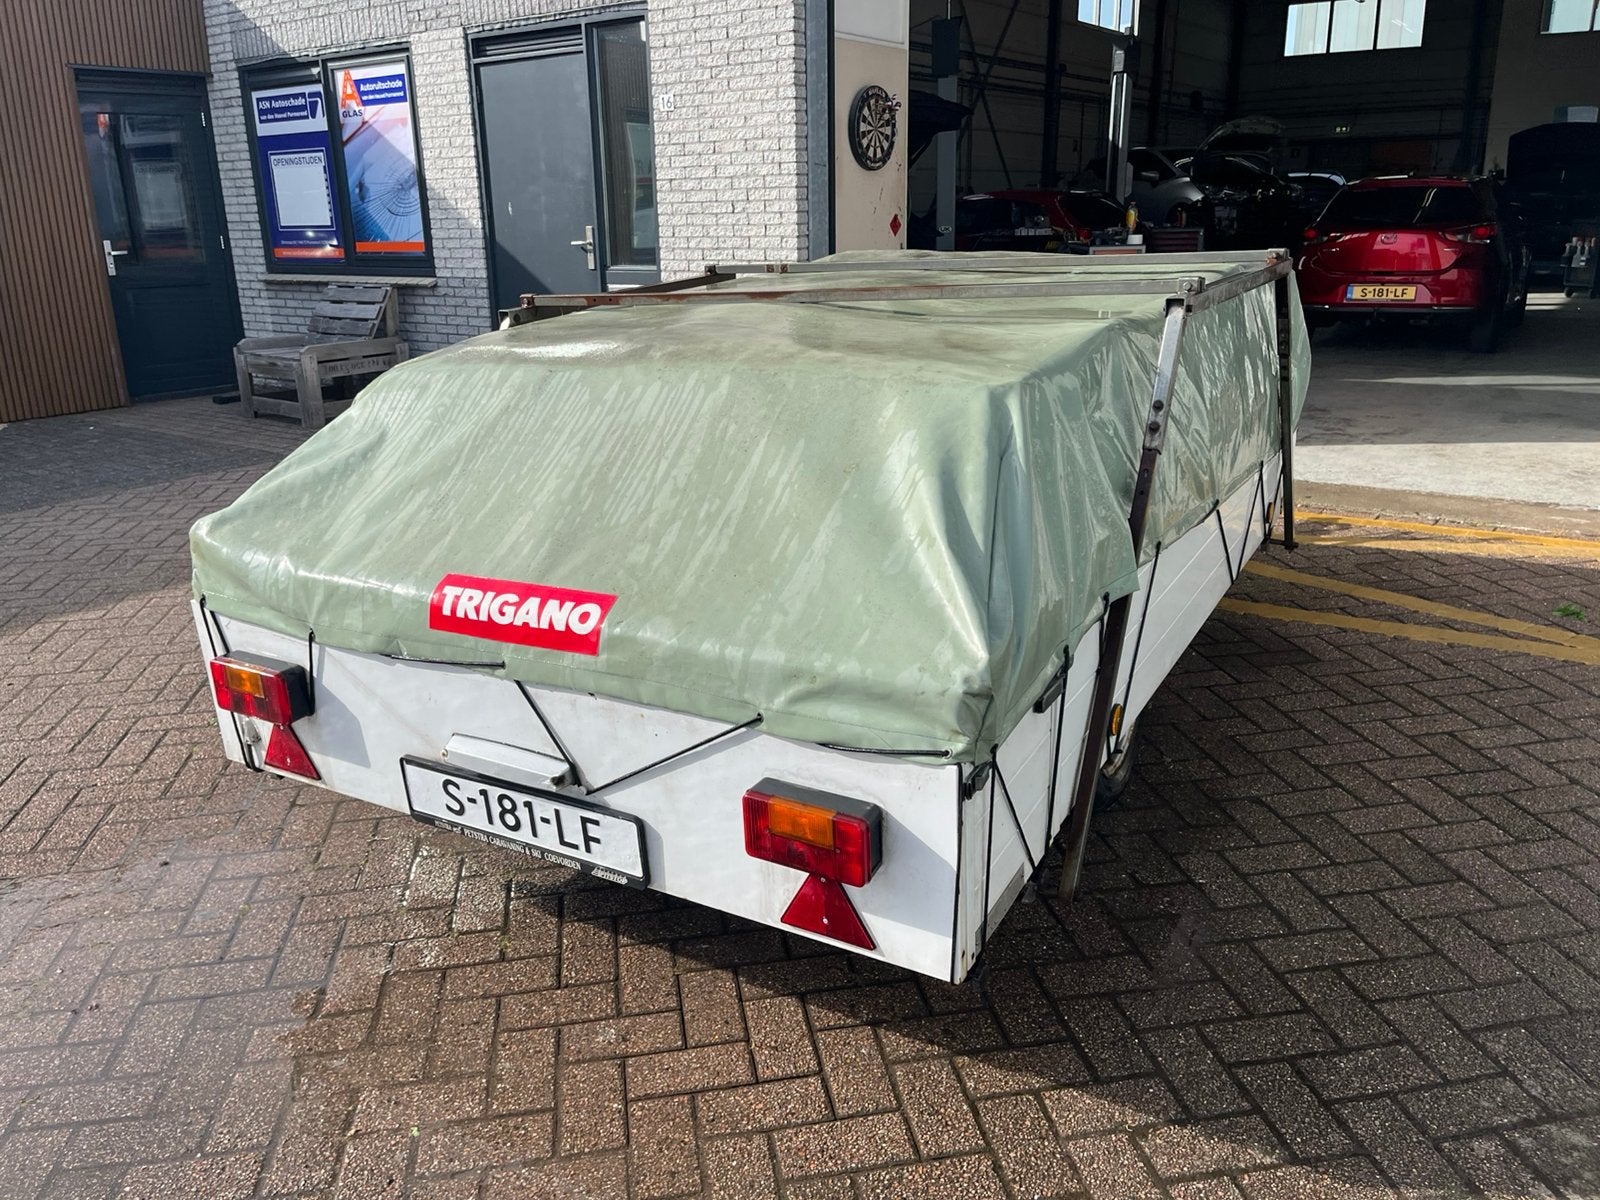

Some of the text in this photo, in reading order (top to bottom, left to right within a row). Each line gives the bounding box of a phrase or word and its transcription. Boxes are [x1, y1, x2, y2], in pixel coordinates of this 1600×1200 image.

[360, 80, 403, 91] Autoruitschade
[259, 96, 306, 110] ASN Autoschade
[661, 96, 673, 109] 16
[342, 109, 363, 118] GLAS
[272, 156, 323, 166] OPENINGSTIJDEN
[1360, 288, 1408, 298] S-181-LF
[442, 585, 602, 635] TRIGANO
[441, 778, 602, 854] S-181-LF
[525, 847, 530, 855] &
[531, 849, 542, 859] SKI
[543, 852, 582, 871] COEVORDEN
